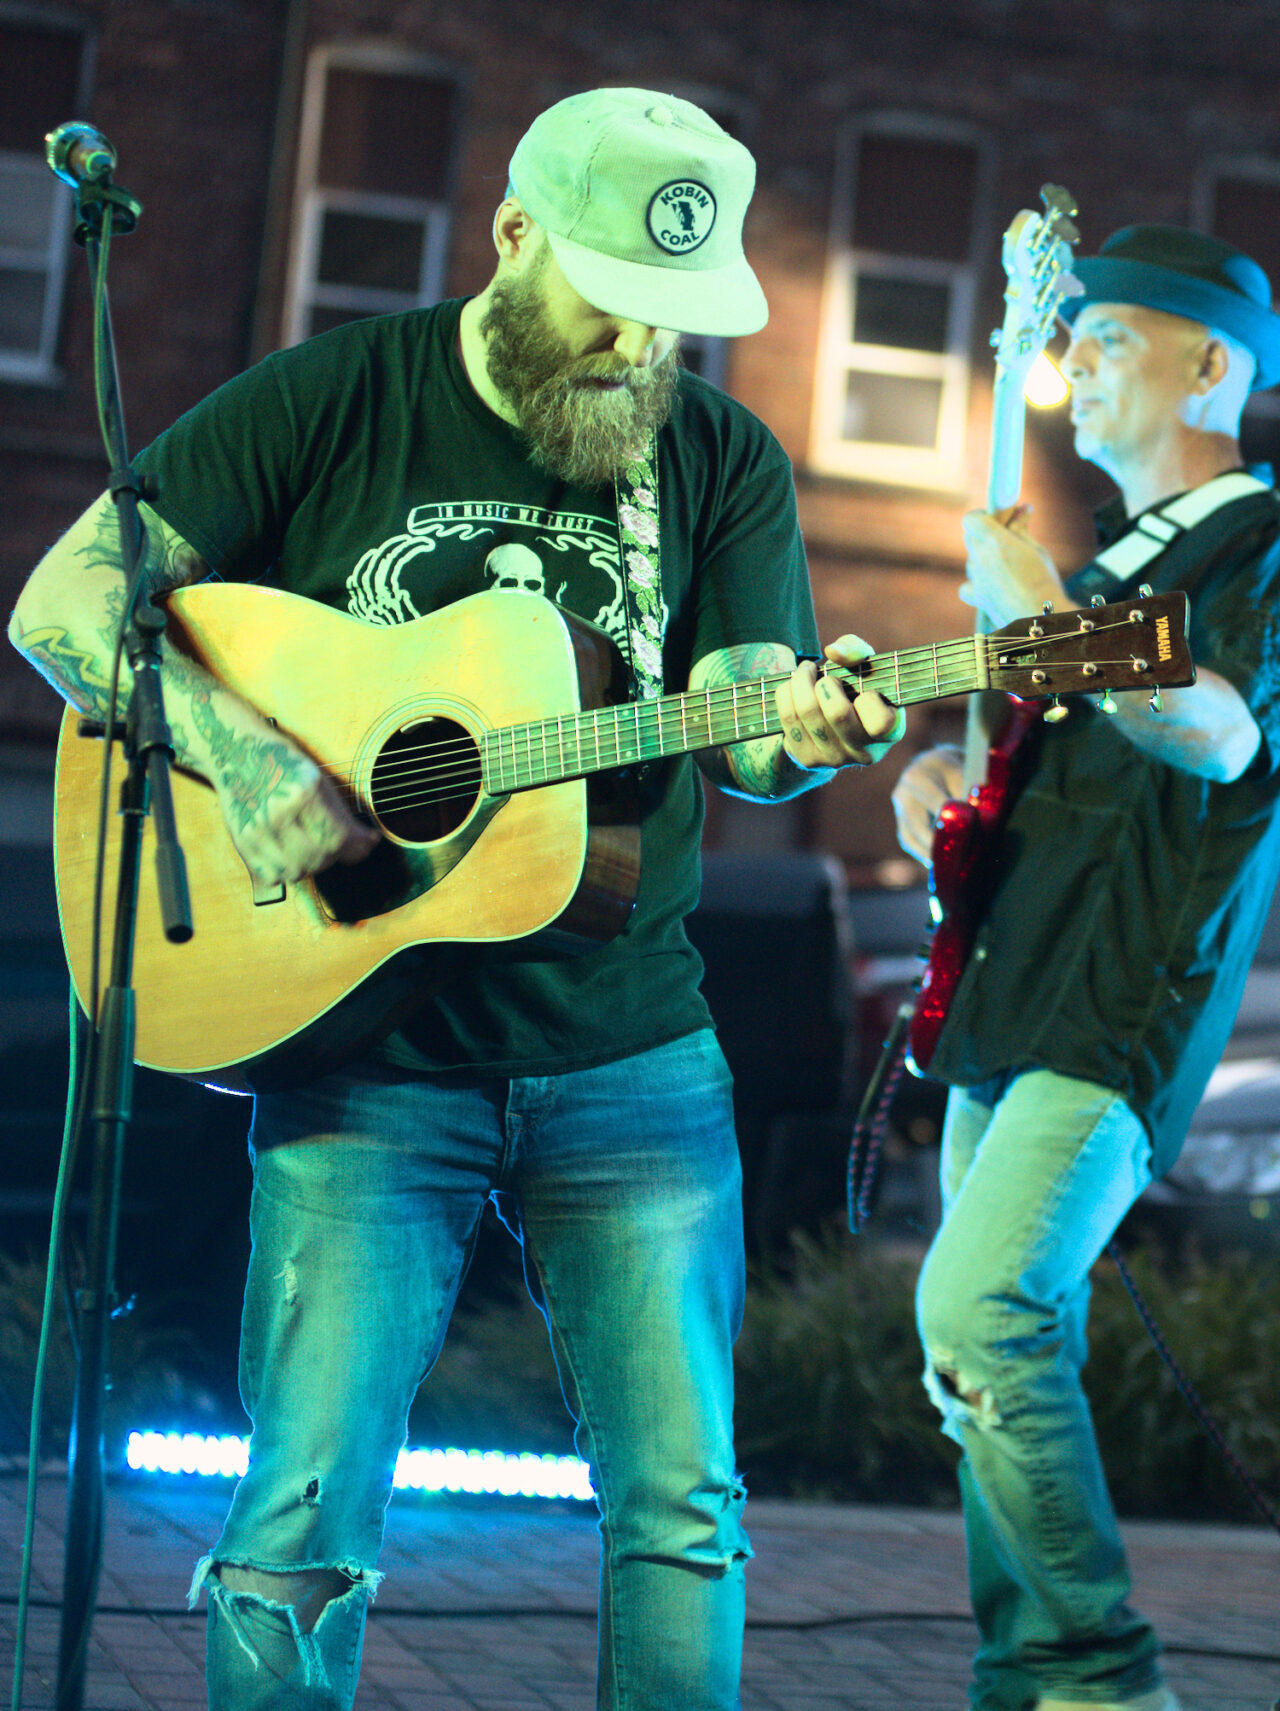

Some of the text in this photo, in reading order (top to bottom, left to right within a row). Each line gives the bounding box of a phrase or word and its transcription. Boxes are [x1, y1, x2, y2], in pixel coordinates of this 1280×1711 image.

[660, 186, 709, 209] KOBIN
[660, 229, 700, 246] COAL
[438, 504, 594, 531] IN MUSIC WE TRUST
[1155, 616, 1173, 663] YAMAHA
